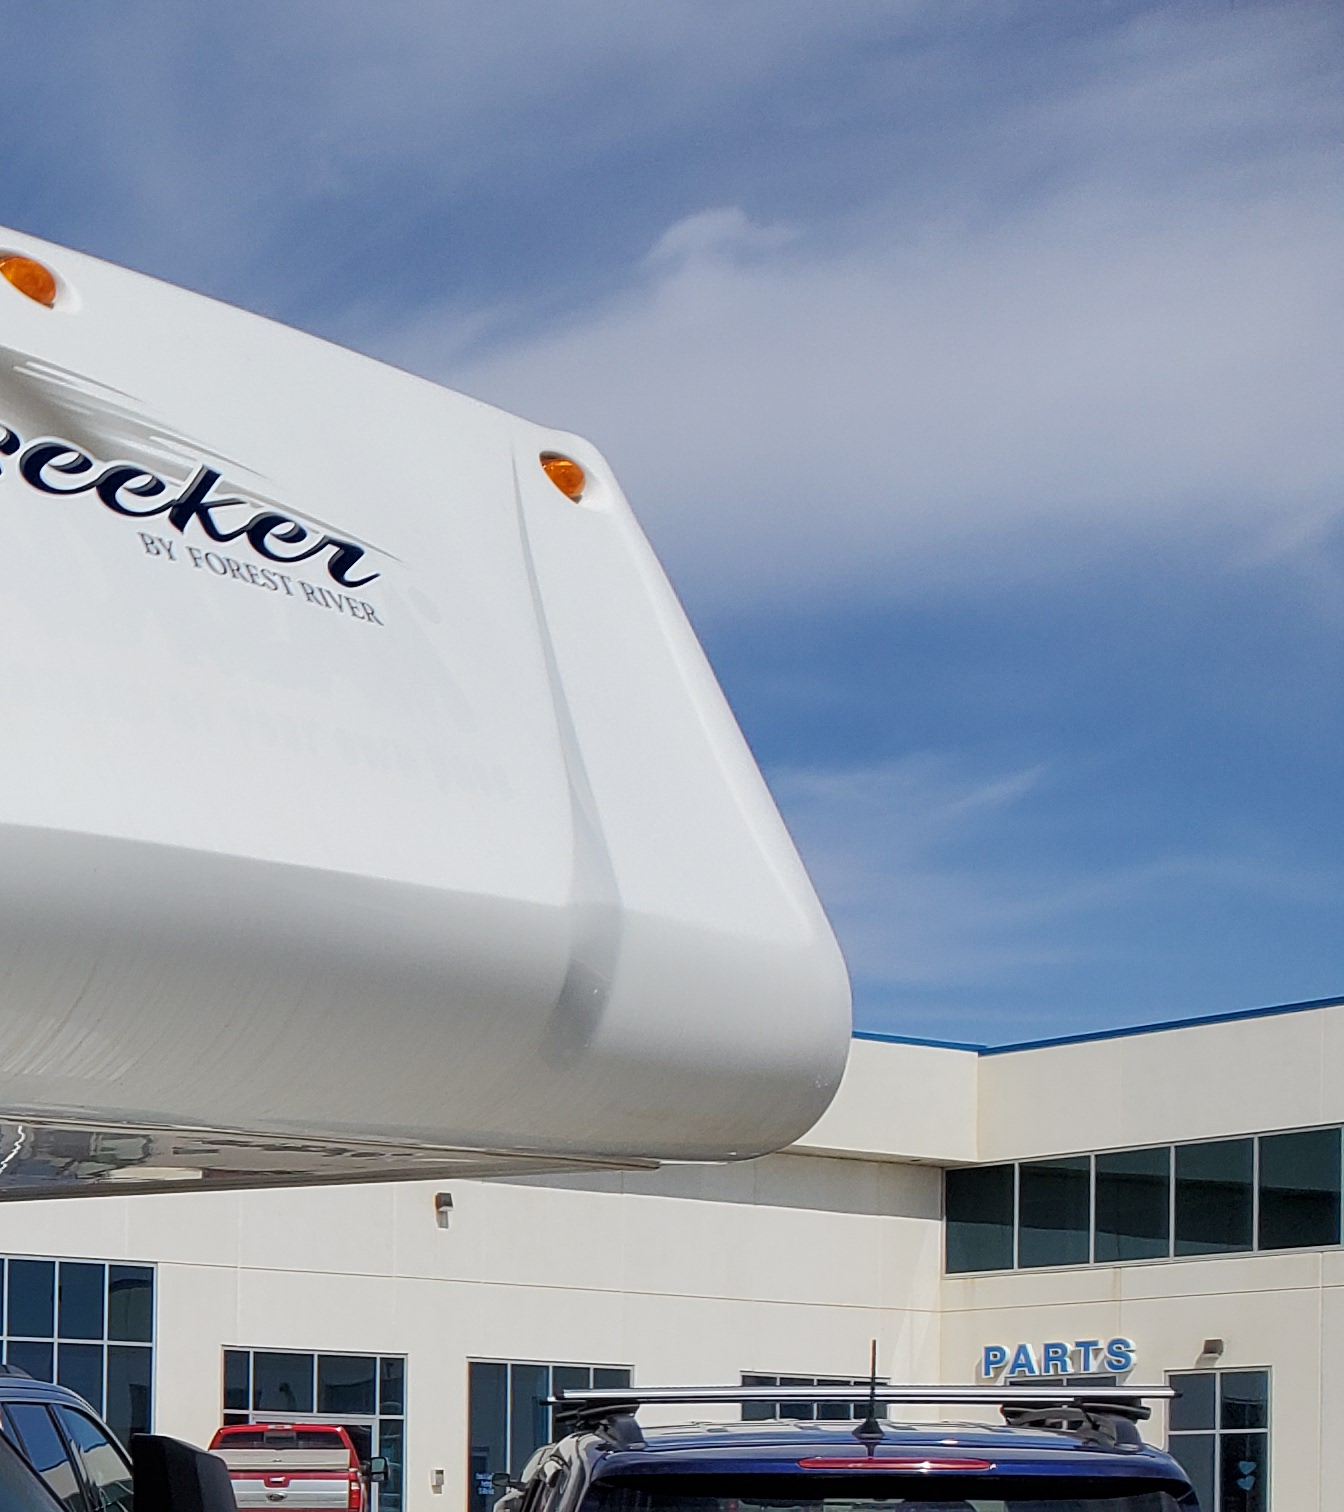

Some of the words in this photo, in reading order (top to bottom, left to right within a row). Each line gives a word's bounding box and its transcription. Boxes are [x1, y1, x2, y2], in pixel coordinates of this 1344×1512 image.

[137, 531, 177, 561] BY
[185, 545, 294, 597] FOREST
[297, 580, 385, 627] RIVER
[981, 1336, 1136, 1379] PARTS
